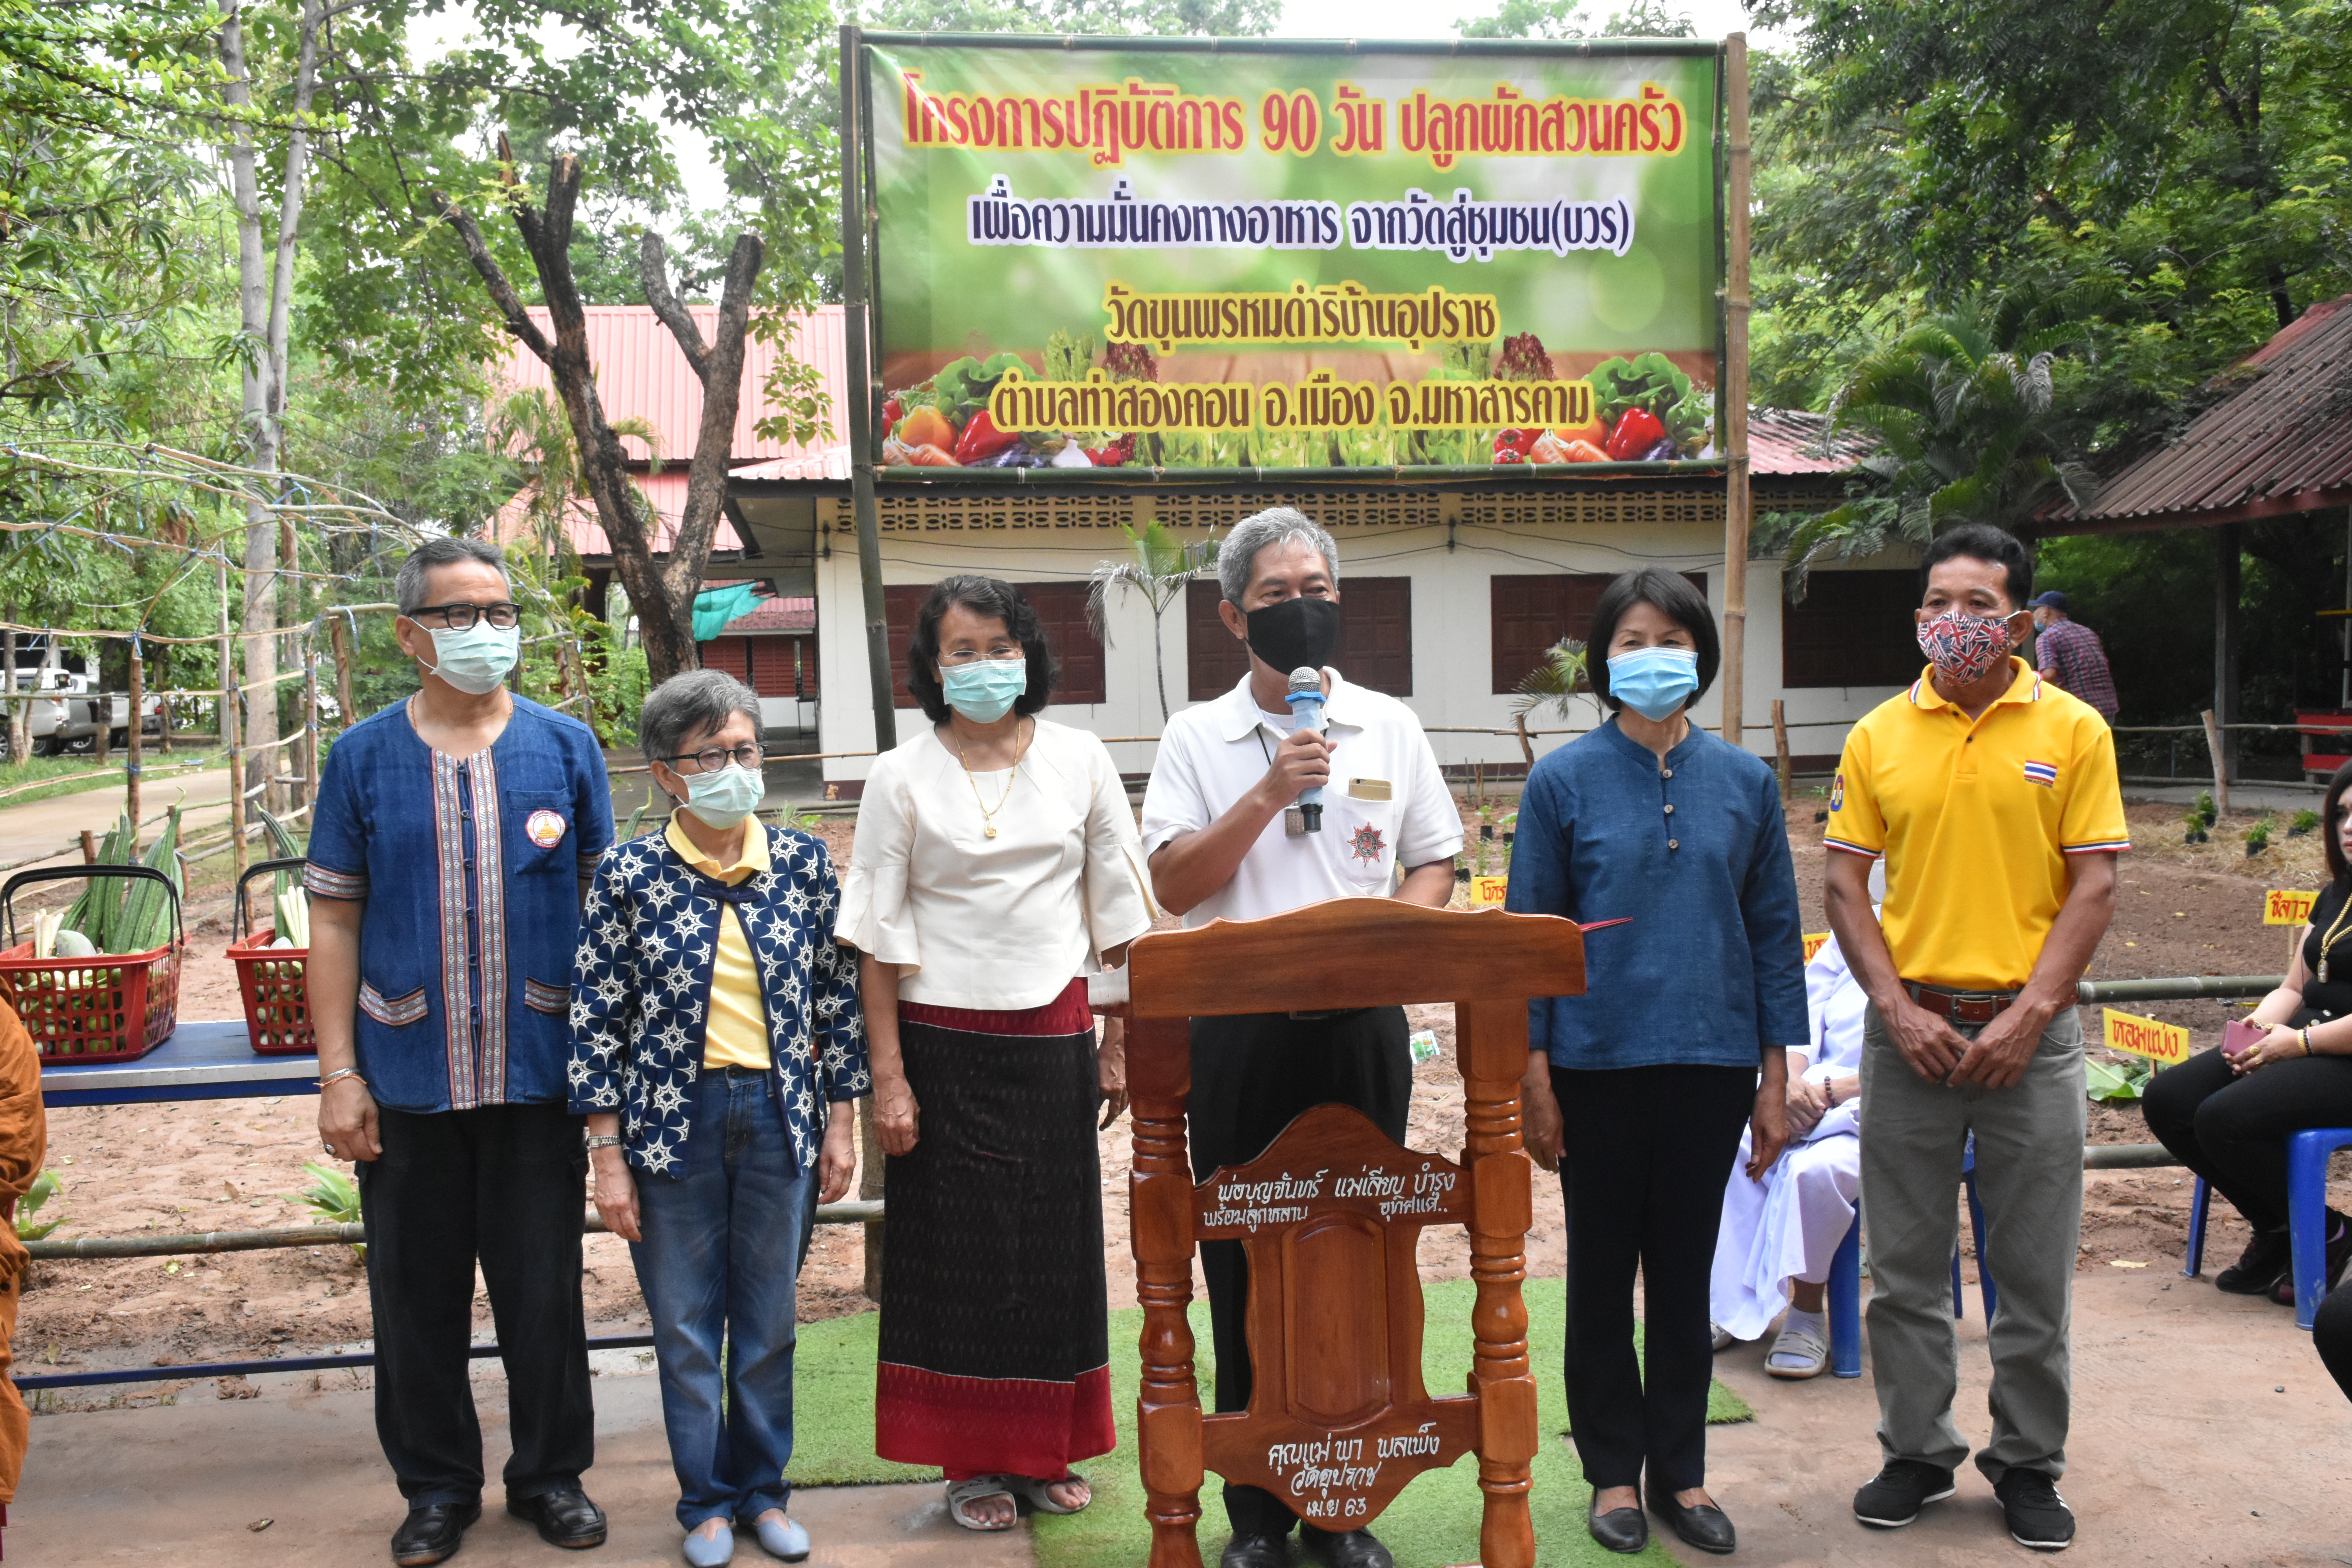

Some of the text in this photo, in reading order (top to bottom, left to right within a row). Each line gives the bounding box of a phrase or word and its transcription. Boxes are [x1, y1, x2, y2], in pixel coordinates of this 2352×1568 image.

[903, 73, 1681, 168] โครงการปฏิบัติการ 90 วัน ปลูกผักสวนครัว
[973, 179, 1629, 257] เพื่อความมั่นคงทางอาหาร จากวัดสู่ชุมชน(บวร)
[1107, 285, 1495, 350] วัดขุนพรหมดำริบ้านอุปราช
[995, 373, 1589, 428] ตำบลท่าสองคอน อ.เมือง จ.มหาสารคาม
[1479, 880, 1507, 901] โหร
[2112, 1018, 2178, 1058] หอมแบ่ง
[1218, 1169, 1329, 1208] พ่อบุญจันทร์
[1414, 1162, 1456, 1200] บำรุง
[1291, 1461, 1382, 1500] วัดอุปราช
[1345, 1497, 1367, 1517] 63
